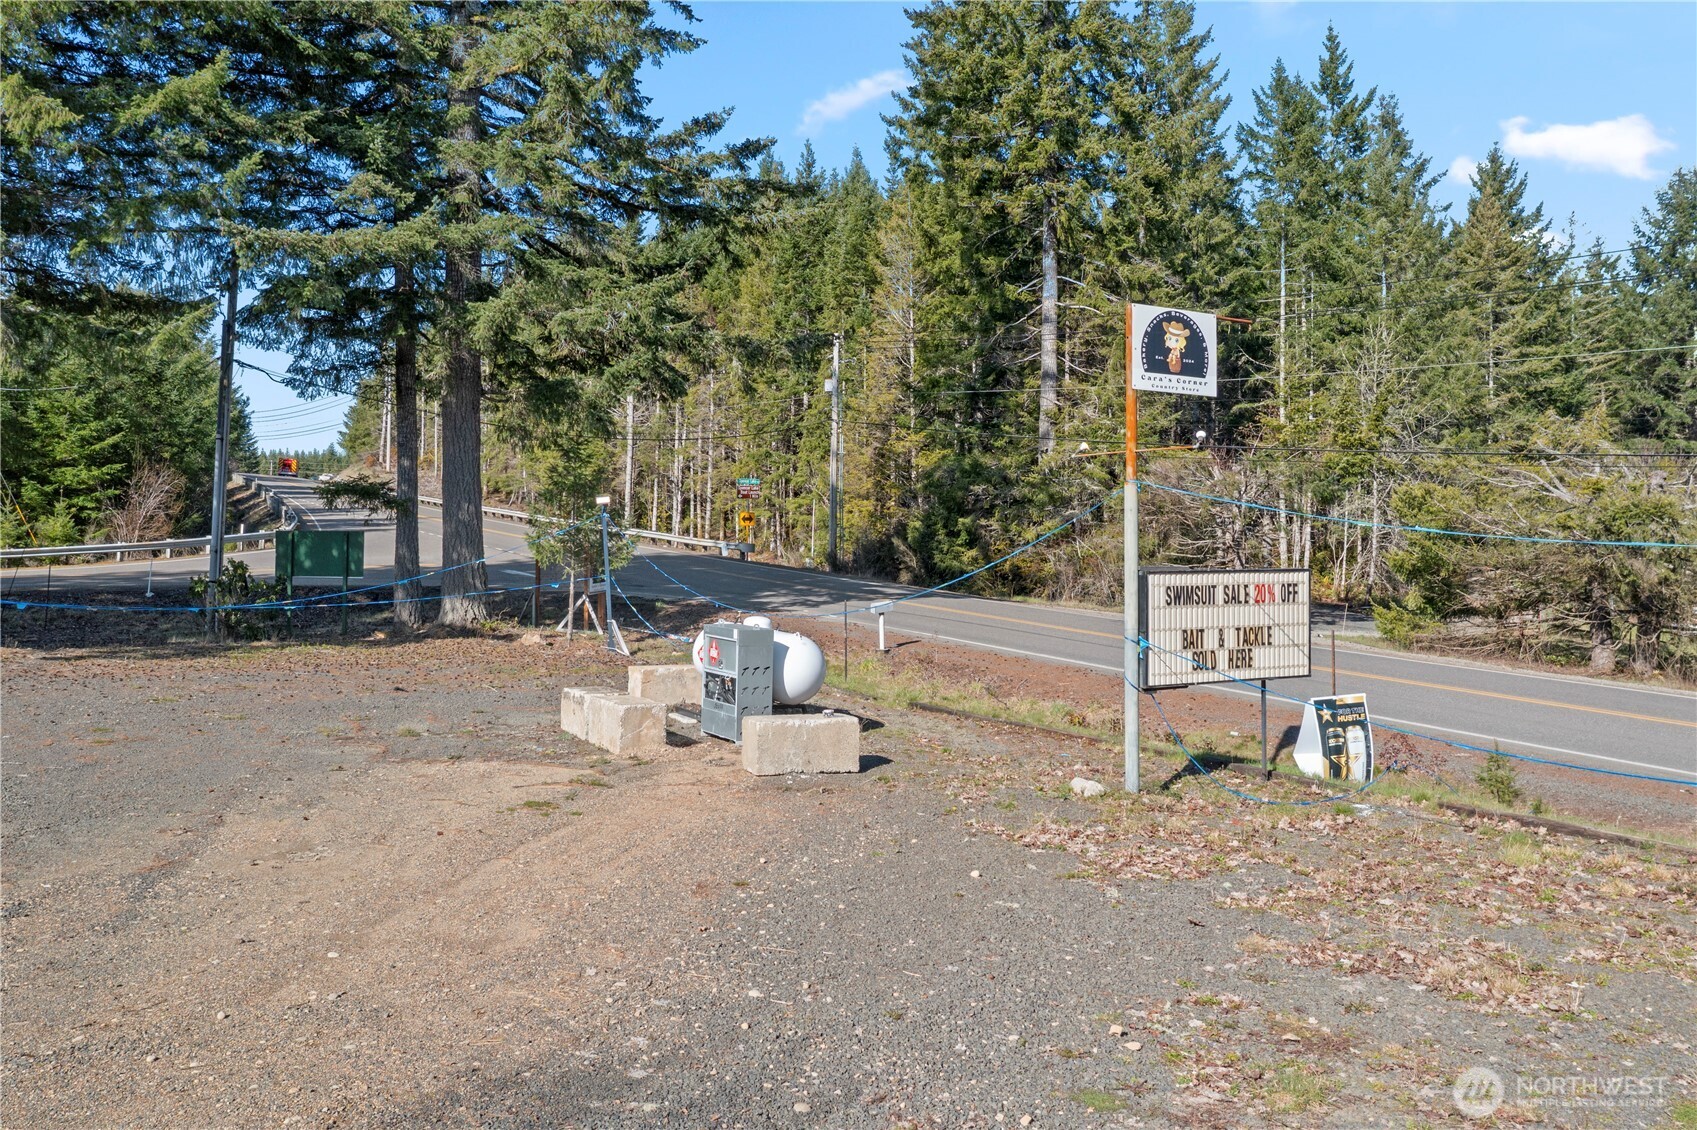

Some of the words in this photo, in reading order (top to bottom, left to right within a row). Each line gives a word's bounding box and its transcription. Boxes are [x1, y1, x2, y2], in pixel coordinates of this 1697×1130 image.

[1141, 374, 1172, 383] Cara's
[1176, 378, 1208, 386] Corner
[1165, 585, 1217, 606] SWIMSUIT
[1223, 584, 1250, 605] SALE
[1254, 583, 1276, 604] 20%
[1280, 583, 1298, 603] OFF
[1182, 629, 1205, 650] BAIT
[1218, 629, 1225, 648] &
[1235, 626, 1273, 647] TACKLE
[1192, 650, 1217, 671] SOLD
[1228, 648, 1253, 670] HERE
[1338, 713, 1365, 722] HUSTLE
